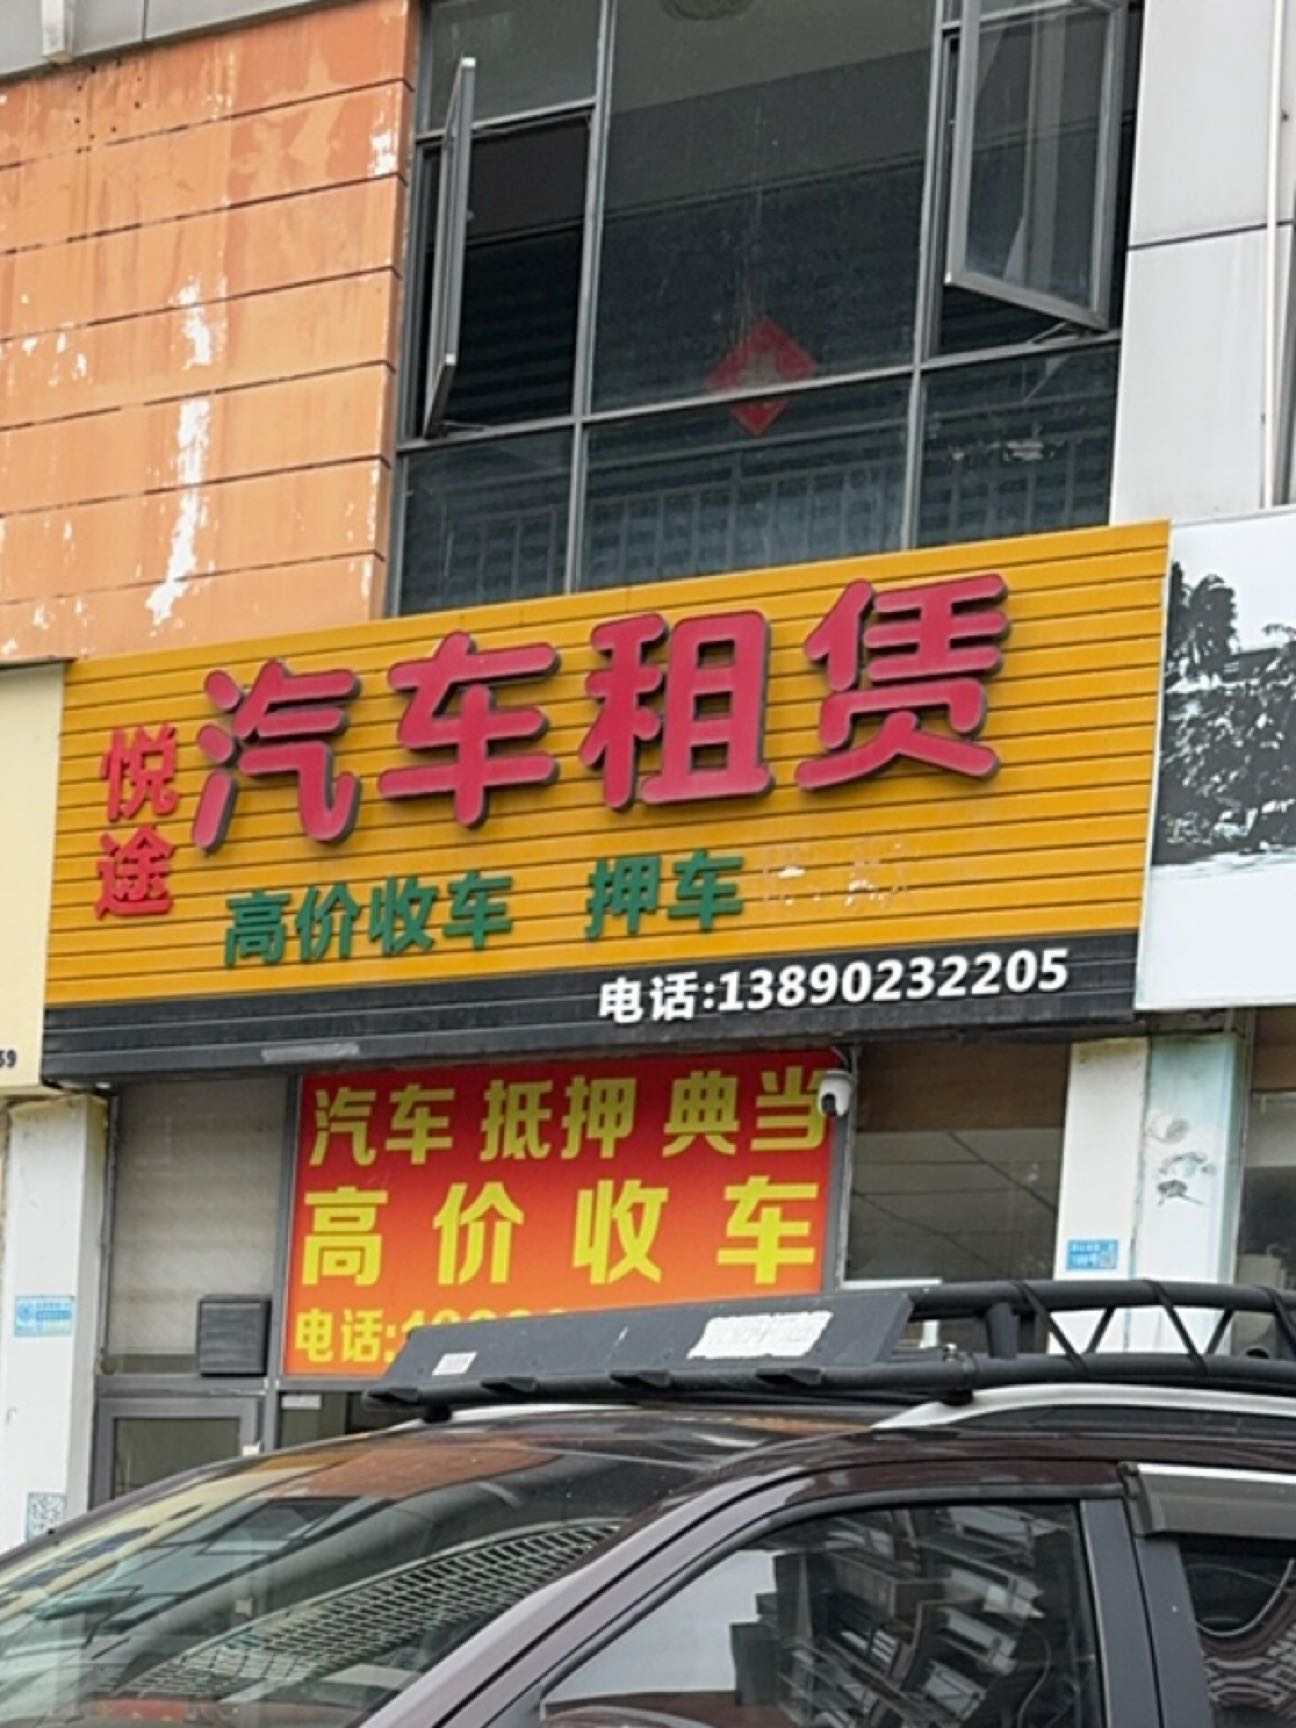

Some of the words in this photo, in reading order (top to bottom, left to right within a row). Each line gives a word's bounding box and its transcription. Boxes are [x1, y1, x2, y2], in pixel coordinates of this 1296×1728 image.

[192, 574, 1010, 852] 汽车租赁
[94, 721, 179, 919] 悦途
[223, 871, 513, 968] 高价收车
[585, 849, 746, 940] 押车
[597, 948, 1071, 1024] 电话:13890232205
[308, 1083, 456, 1166] 汽车
[480, 1077, 636, 1161] 抵押
[663, 1064, 829, 1157] 典当
[301, 1174, 820, 1286] 高价收车
